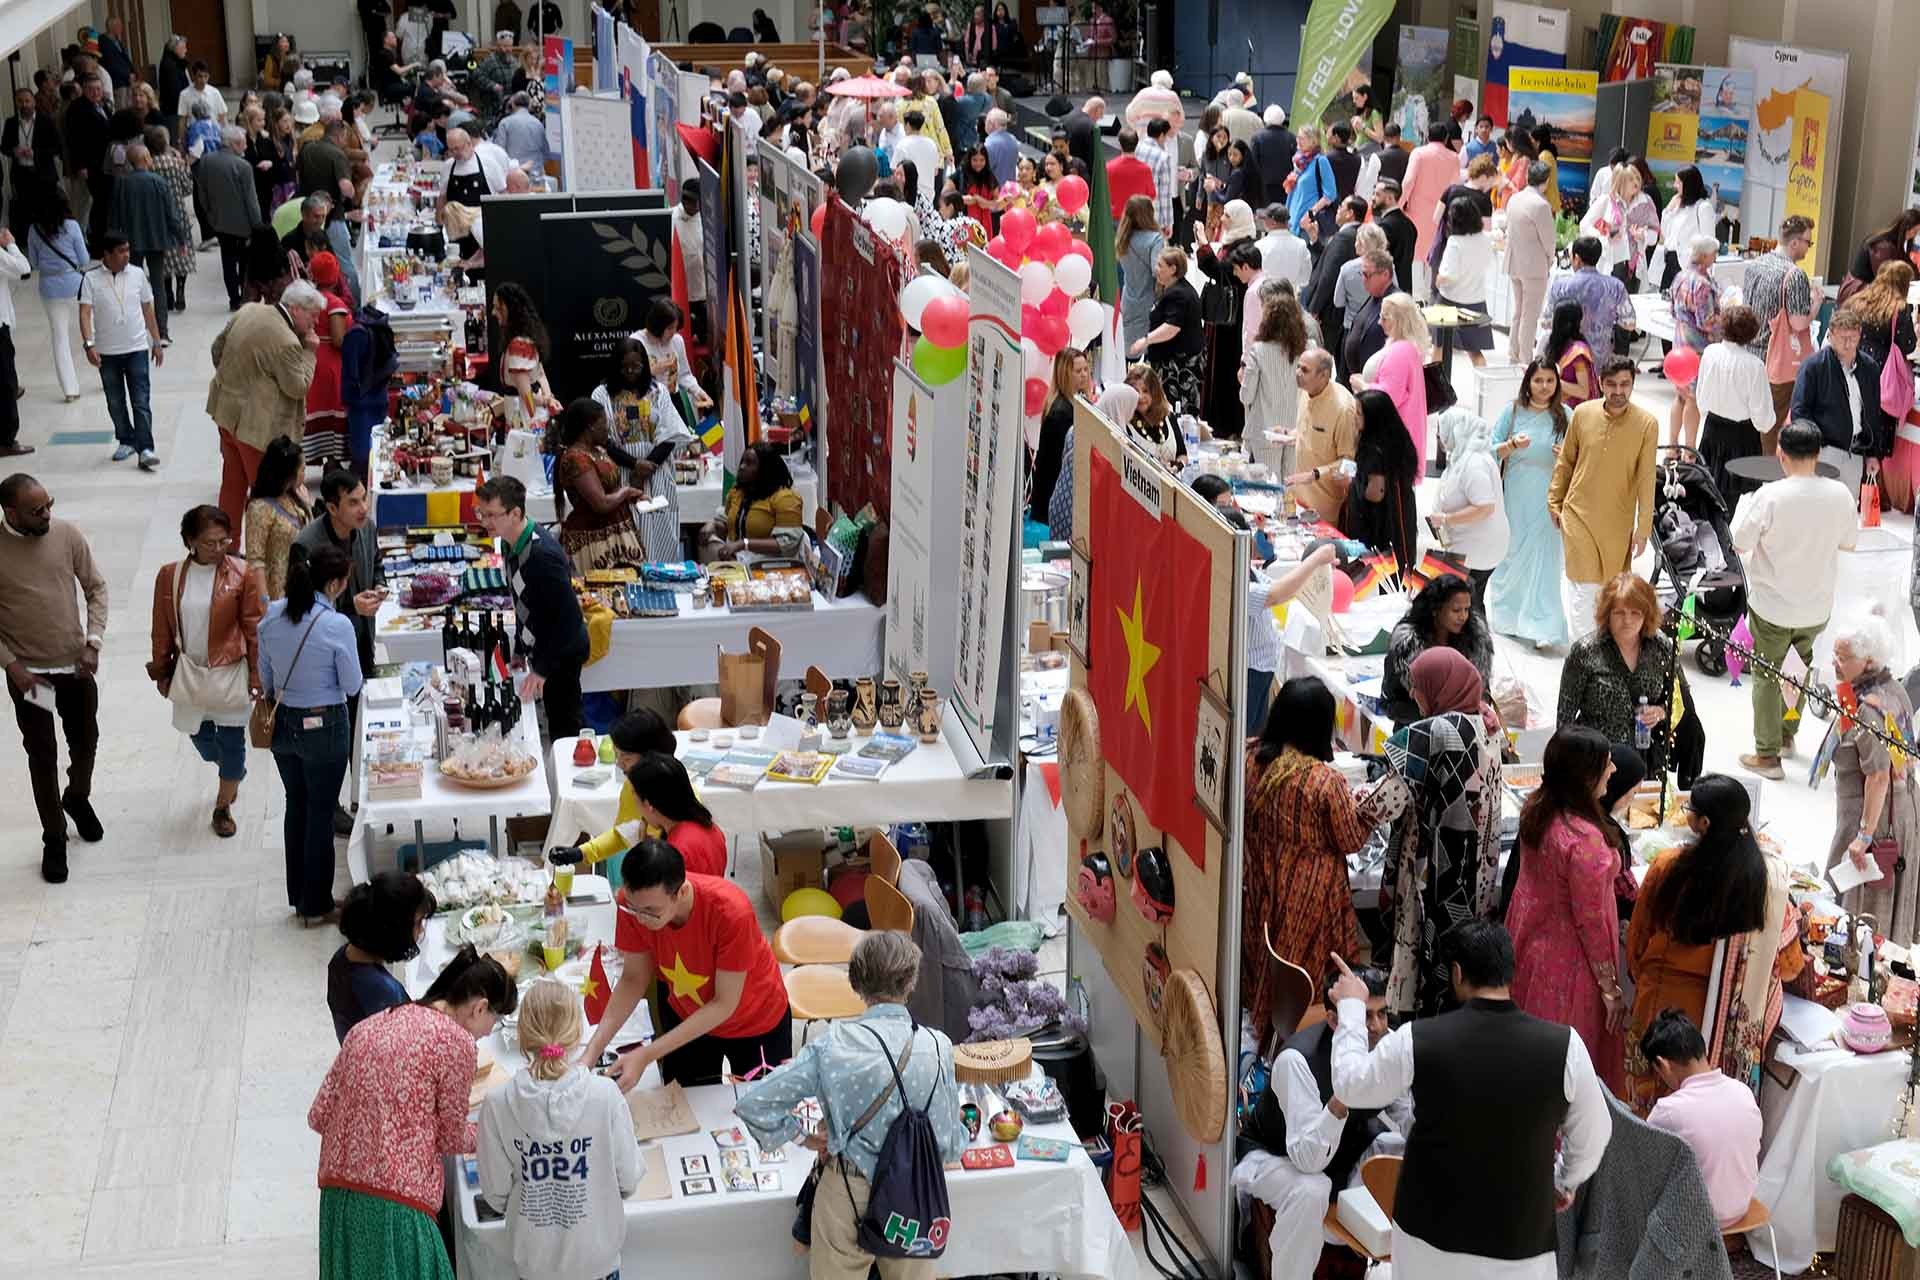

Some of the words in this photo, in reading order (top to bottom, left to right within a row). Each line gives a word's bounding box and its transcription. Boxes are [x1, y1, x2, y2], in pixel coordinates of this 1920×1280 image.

[1774, 50, 1798, 63] Cyprus
[1308, 54, 1336, 99] FEEL
[1123, 455, 1160, 508] Vietnam
[514, 1139, 563, 1157] CLASS
[570, 1136, 592, 1154] OF
[521, 1155, 589, 1182] 2024
